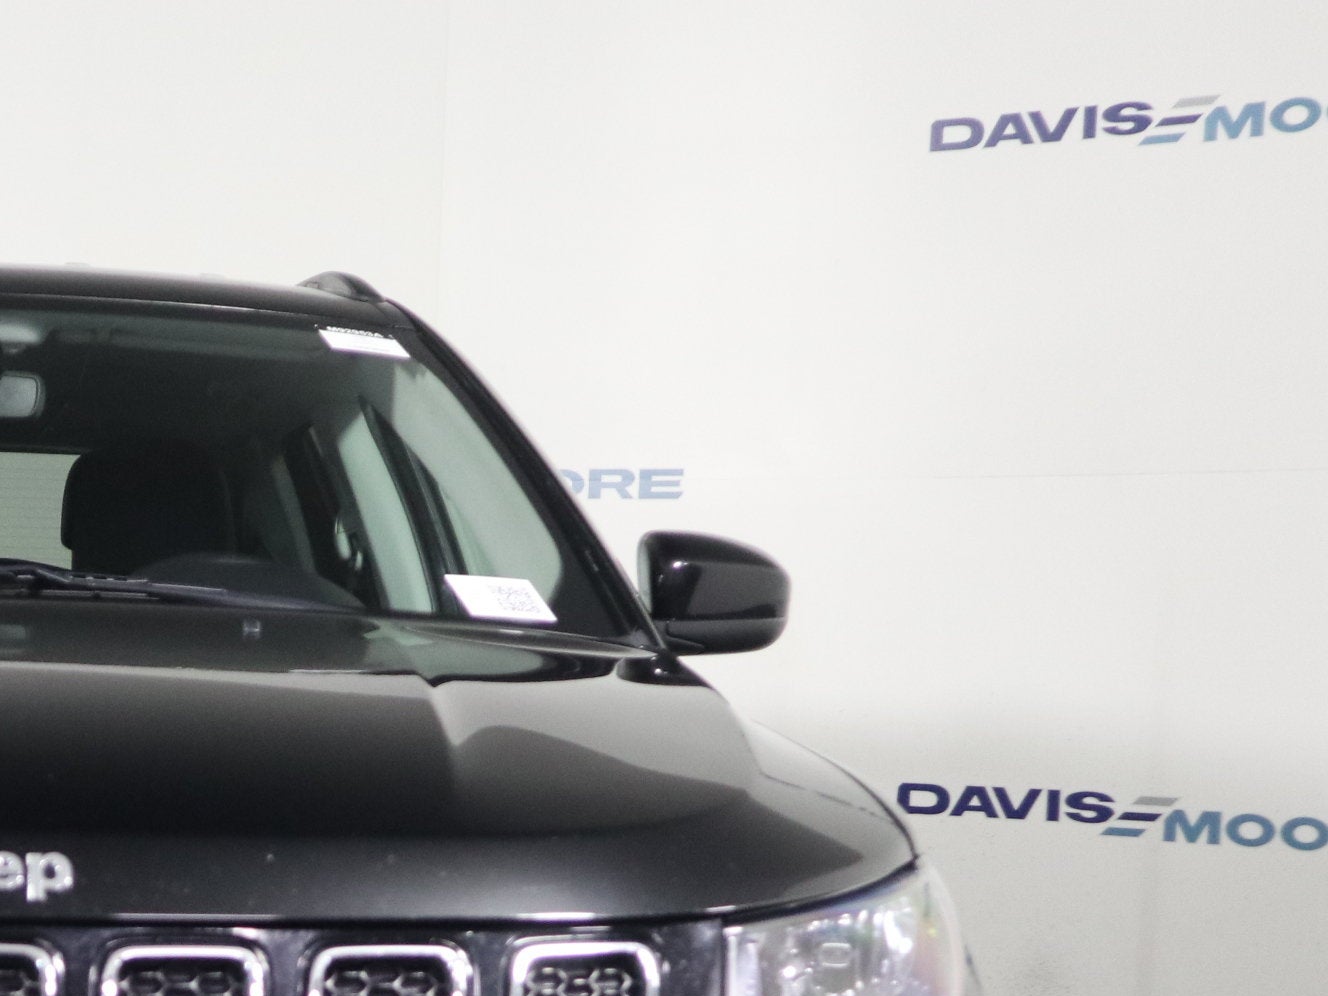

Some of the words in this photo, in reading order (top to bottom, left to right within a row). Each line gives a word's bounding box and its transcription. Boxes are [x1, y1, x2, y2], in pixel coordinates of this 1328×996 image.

[929, 100, 1154, 153] DAVIS
[1203, 96, 1328, 143] MO
[895, 781, 1117, 825] DAVIS
